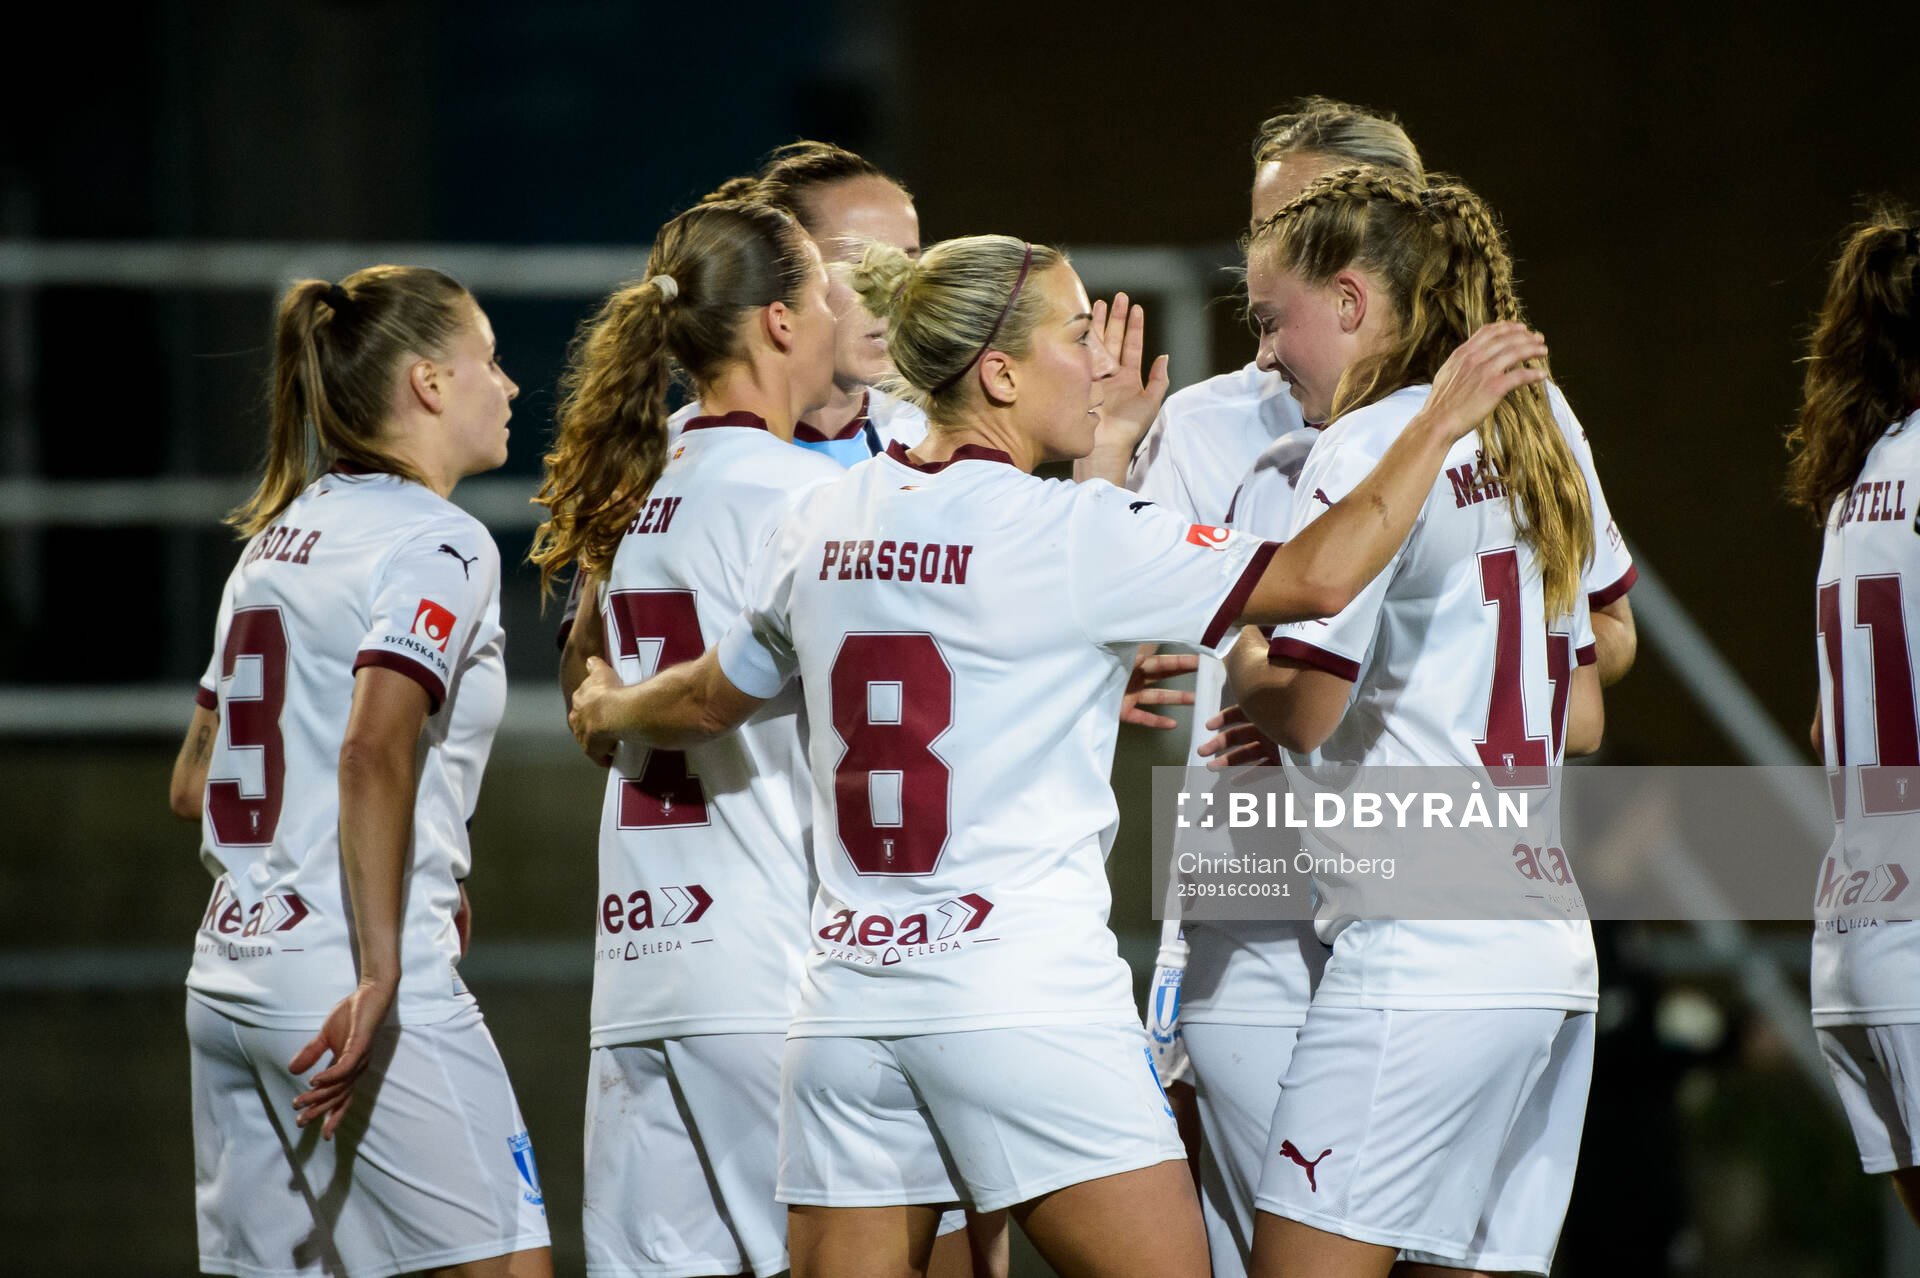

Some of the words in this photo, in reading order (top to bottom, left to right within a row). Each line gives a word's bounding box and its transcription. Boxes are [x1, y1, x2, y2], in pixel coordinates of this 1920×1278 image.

[819, 540, 973, 585] PERSSON
[383, 635, 434, 661] SVENSKA
[1817, 572, 1920, 823] 11
[202, 605, 291, 848] 3
[828, 631, 956, 878] 8
[608, 947, 621, 960] OF
[642, 940, 682, 955] ELEDA
[907, 942, 962, 958] ELEDA
